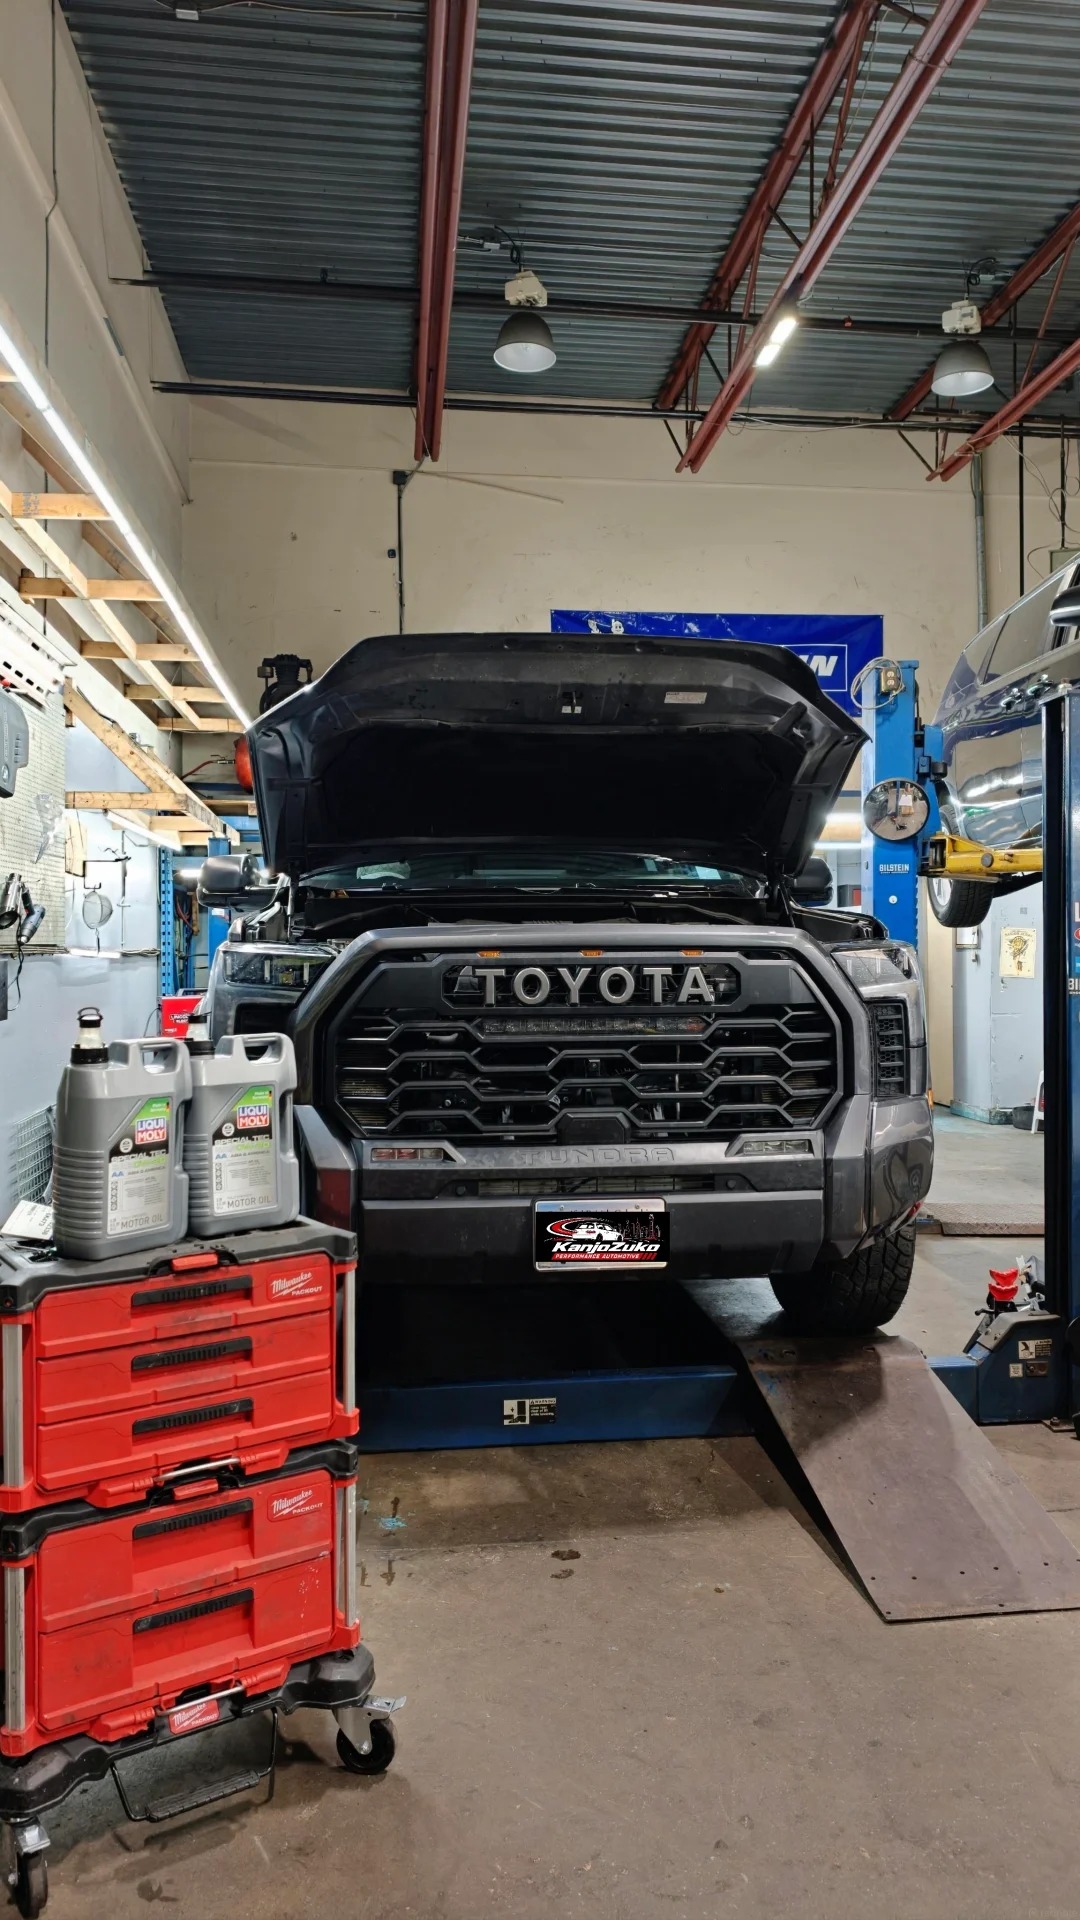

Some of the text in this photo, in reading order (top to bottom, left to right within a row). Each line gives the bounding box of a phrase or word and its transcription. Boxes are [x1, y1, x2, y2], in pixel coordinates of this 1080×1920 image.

[879, 863, 910, 872] BILSTEIN
[475, 966, 715, 1006] TOYOTA
[239, 1105, 267, 1116] LIQUI
[137, 1118, 164, 1131] LIQUI
[239, 1115, 267, 1127] MOLY
[137, 1129, 165, 1143] MOLY
[521, 1147, 675, 1166] TUNDRA
[227, 1197, 257, 1209] MOTOR
[258, 1195, 272, 1204] OIL
[120, 1216, 150, 1229] MOTOR
[151, 1212, 163, 1223] OIL
[271, 1272, 313, 1295] Milwaukee
[291, 1285, 323, 1296] PACKOUT
[272, 1490, 313, 1515] Milwaukee
[292, 1502, 323, 1515] PACKOUT
[173, 1703, 207, 1727] Milwaukee
[191, 1713, 218, 1726] PACKOUT
